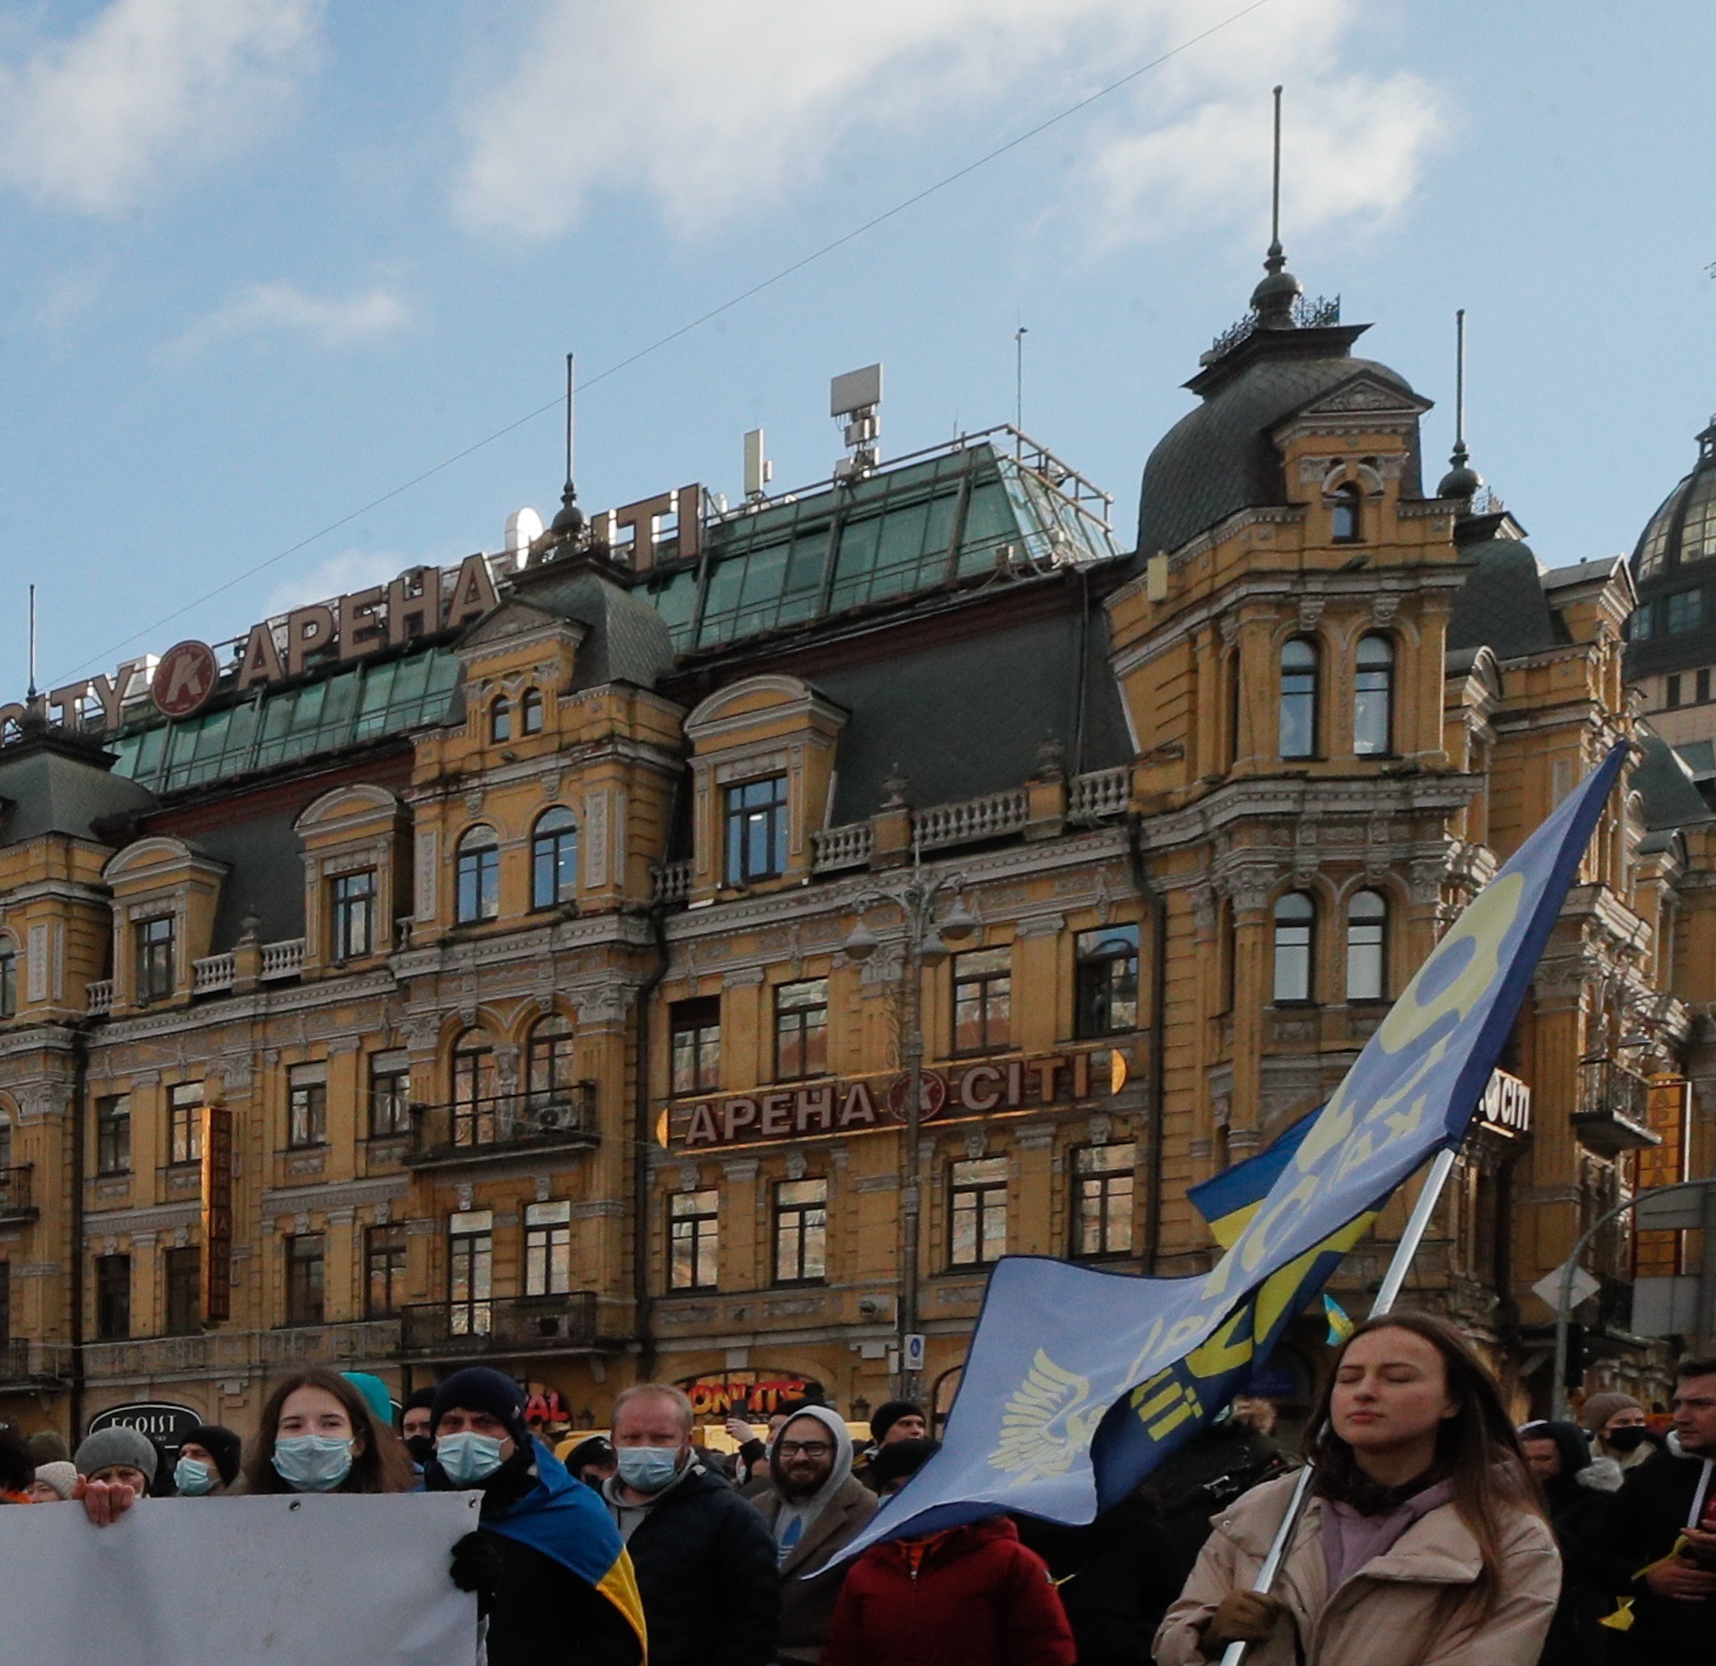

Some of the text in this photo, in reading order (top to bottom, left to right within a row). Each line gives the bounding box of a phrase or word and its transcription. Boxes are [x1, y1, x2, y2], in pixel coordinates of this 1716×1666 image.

[234, 552, 499, 692] АРЕНА
[685, 1080, 877, 1146] АРЕНА
[110, 1413, 178, 1434] EGOIST
